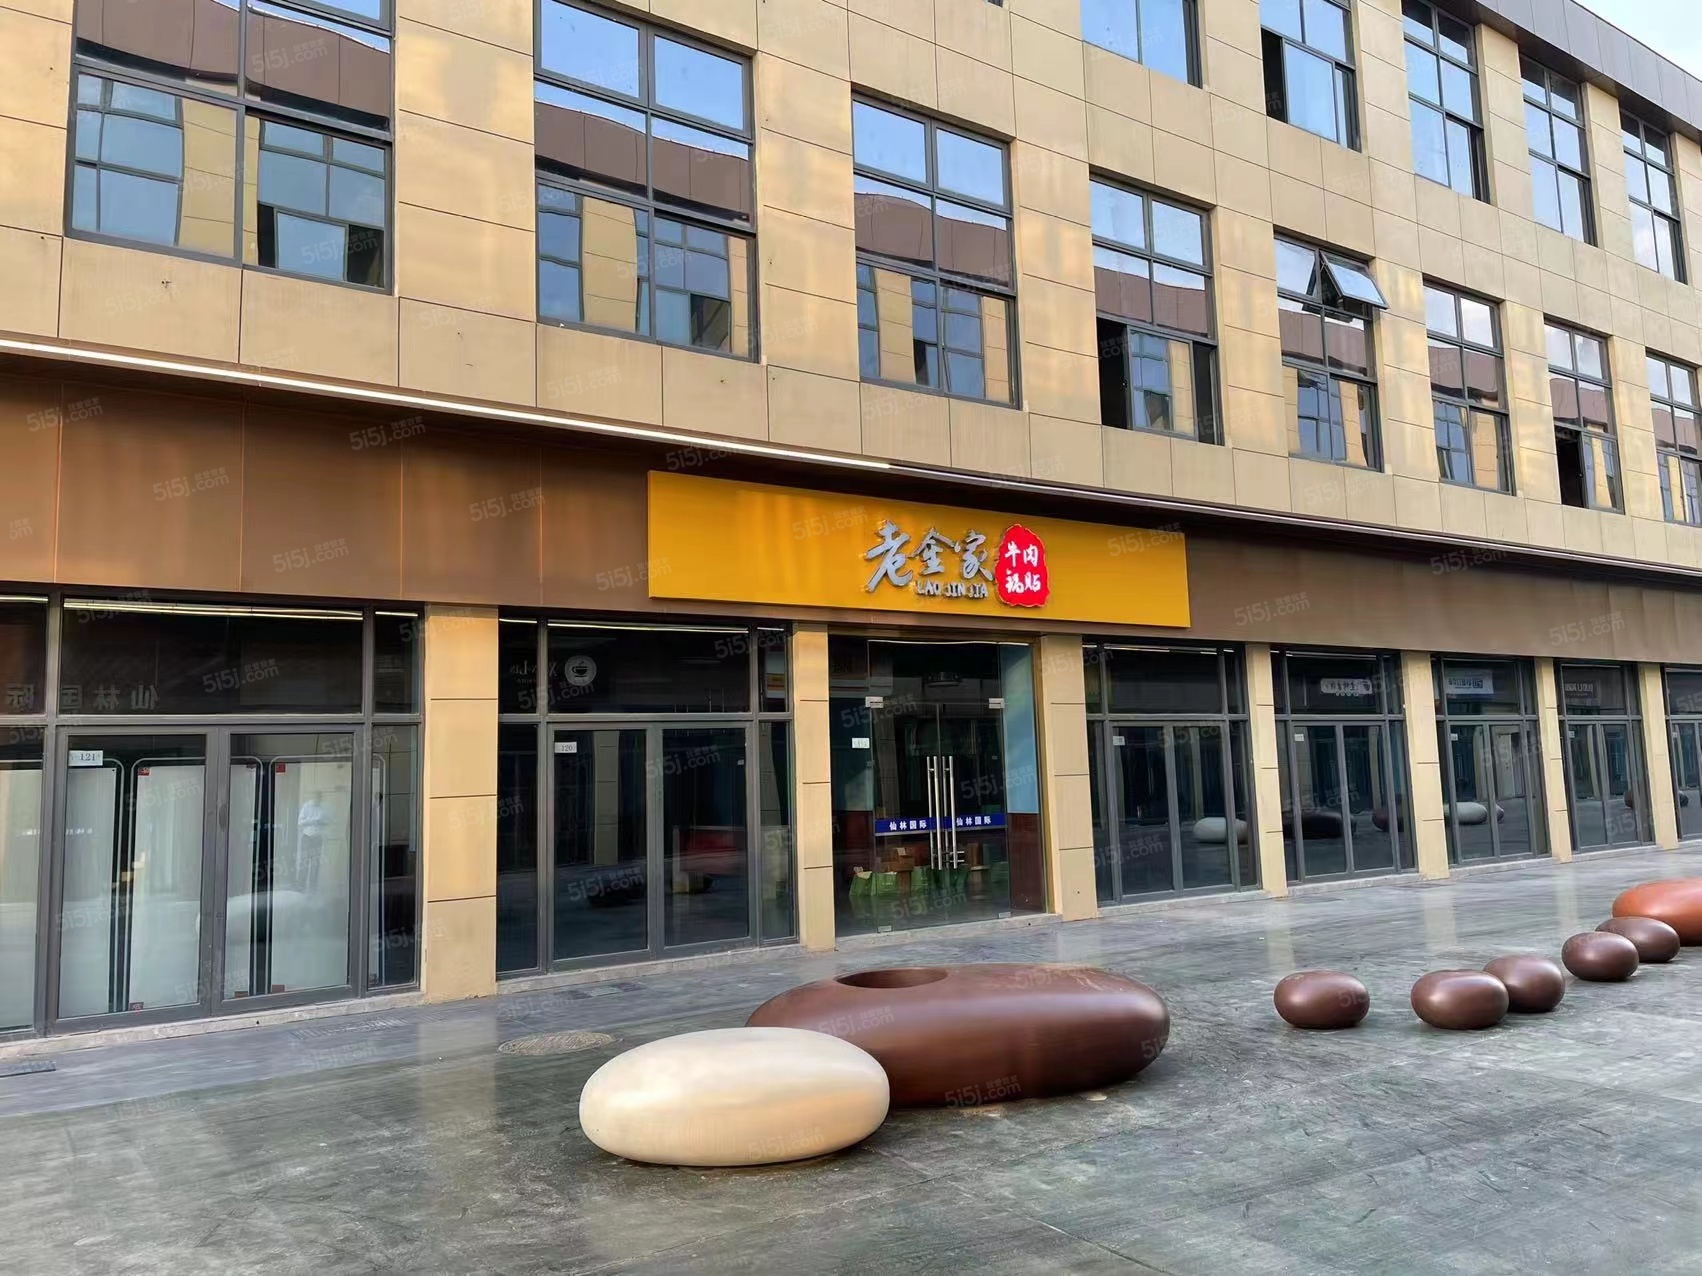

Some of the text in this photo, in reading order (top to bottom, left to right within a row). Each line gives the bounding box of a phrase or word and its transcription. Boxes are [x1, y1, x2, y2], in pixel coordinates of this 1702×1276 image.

[863, 519, 994, 593] 老金家
[1004, 541, 1040, 568] 牛肉
[944, 581, 967, 598] JIN
[968, 583, 990, 599] JIA
[889, 820, 927, 831] 仙林国际
[956, 816, 992, 827] 仙林国际
